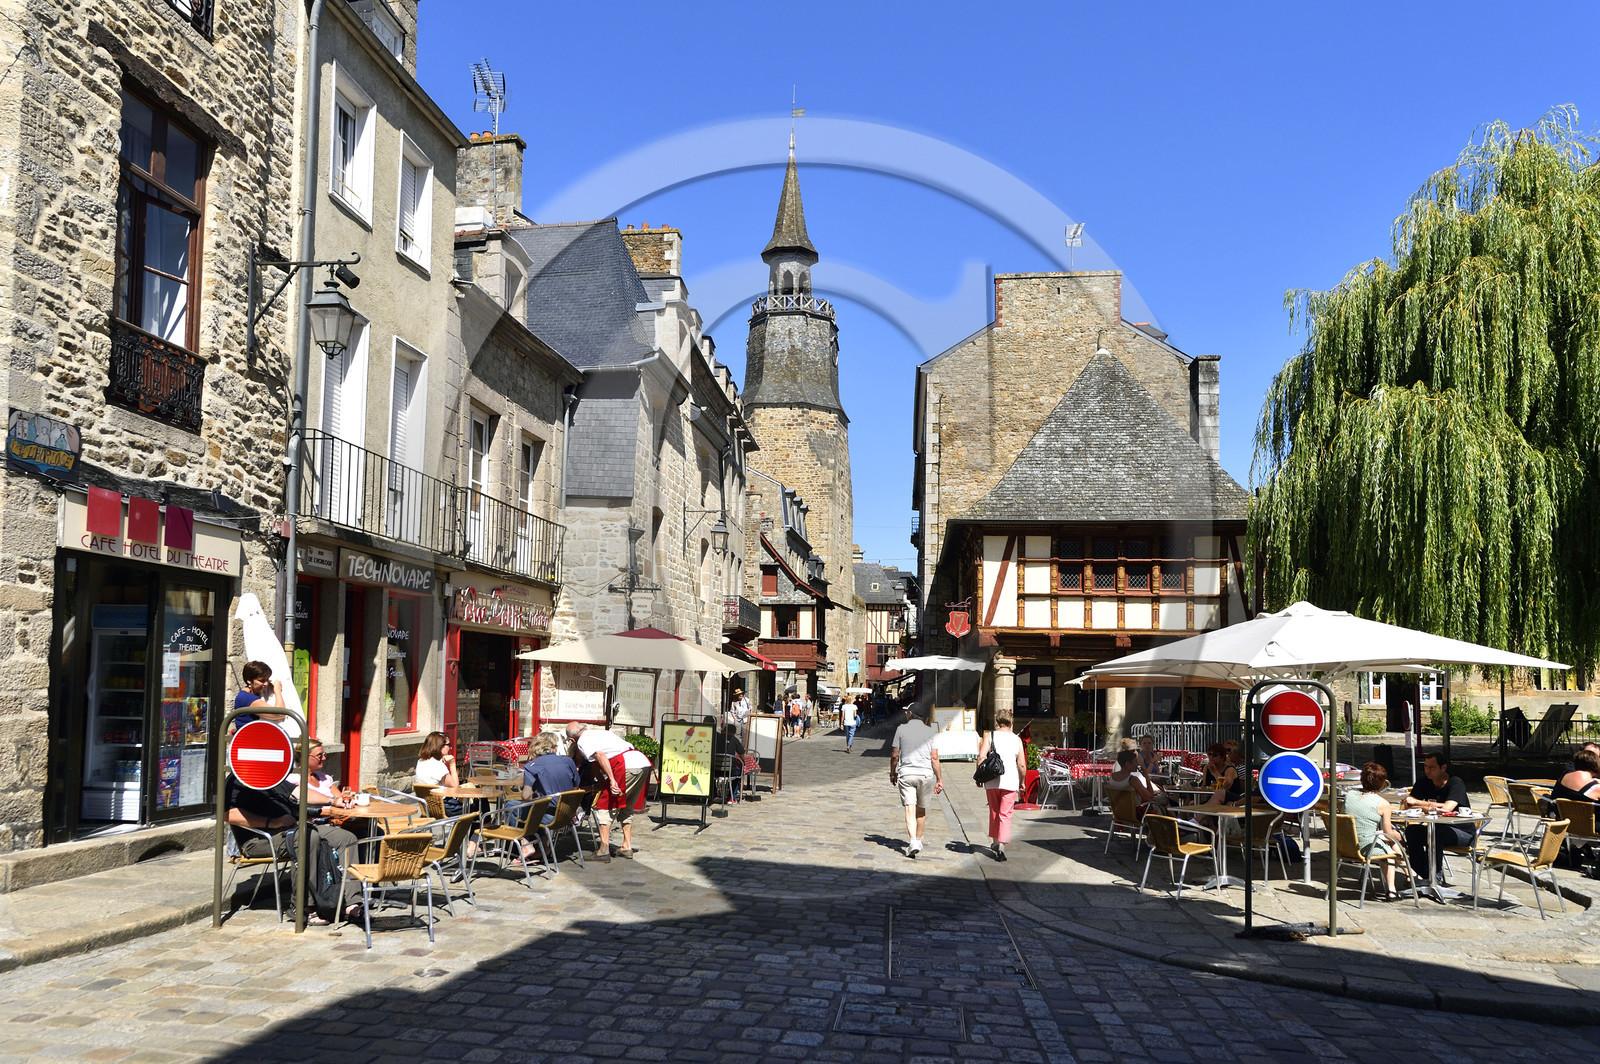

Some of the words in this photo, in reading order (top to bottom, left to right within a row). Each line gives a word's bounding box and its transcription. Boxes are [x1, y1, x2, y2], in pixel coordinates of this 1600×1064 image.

[81, 534, 116, 553] CAFE
[123, 541, 161, 561] HOTEL
[167, 549, 180, 564] DU
[185, 552, 228, 572] THEATRE
[348, 555, 431, 589] TECHNOVAPE
[171, 626, 186, 643] CAFE
[191, 626, 209, 645] HOTEL
[179, 643, 203, 653] THEATRE
[565, 680, 580, 689] NEW
[619, 690, 632, 698] NEW
[634, 691, 651, 700] DELHI
[667, 739, 710, 753] GLACE
